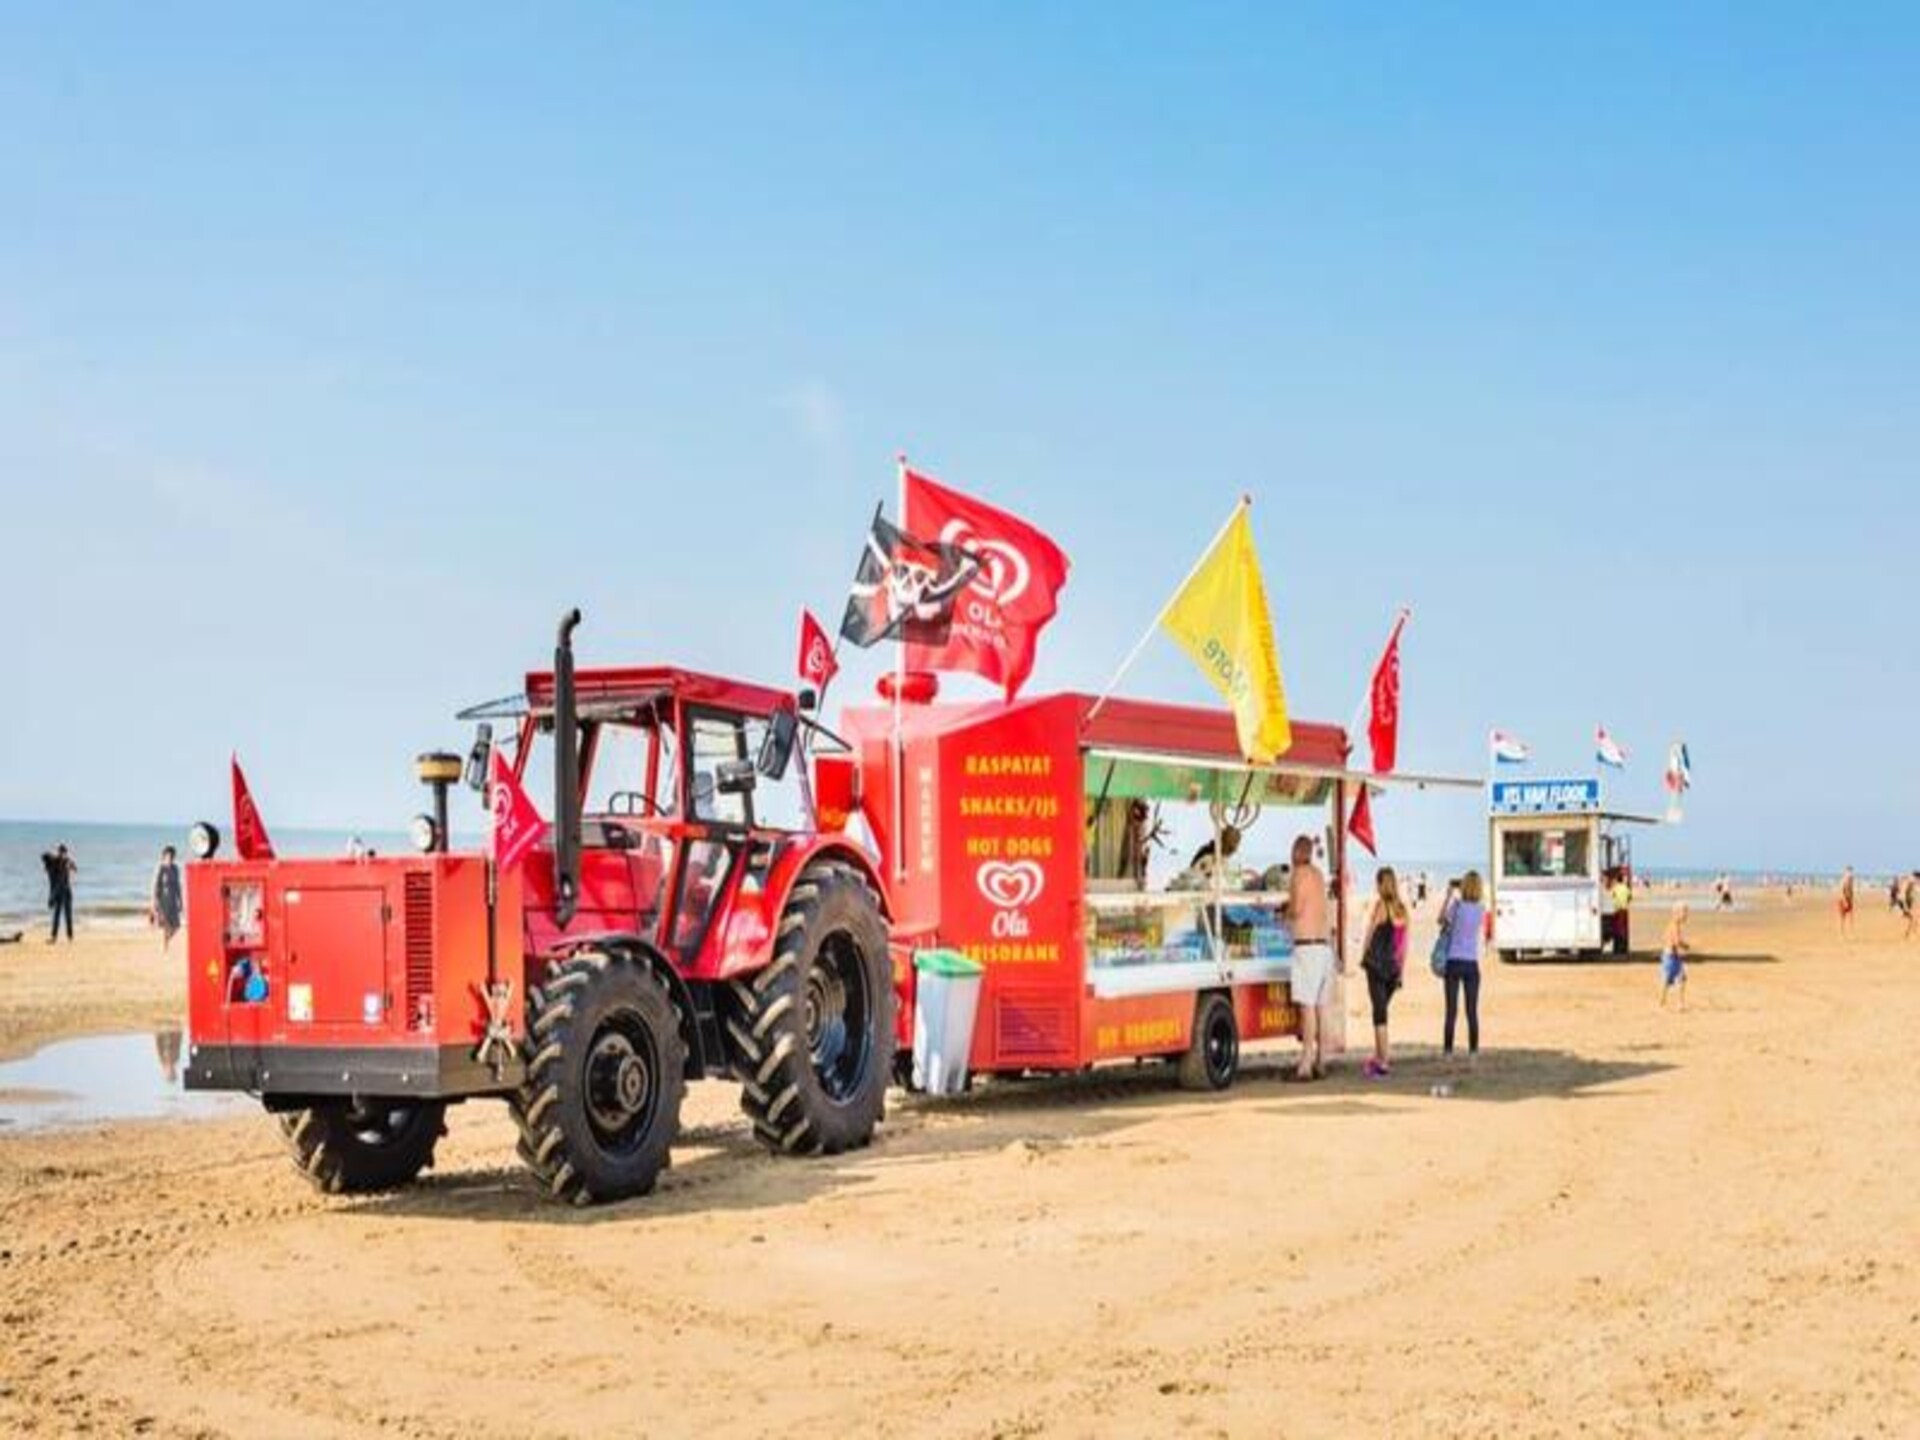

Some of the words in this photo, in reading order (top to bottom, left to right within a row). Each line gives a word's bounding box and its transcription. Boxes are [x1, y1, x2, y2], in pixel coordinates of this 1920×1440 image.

[966, 837, 1000, 857] HOT
[1005, 837, 1053, 857] DOGS
[991, 909, 1030, 939] Ola
